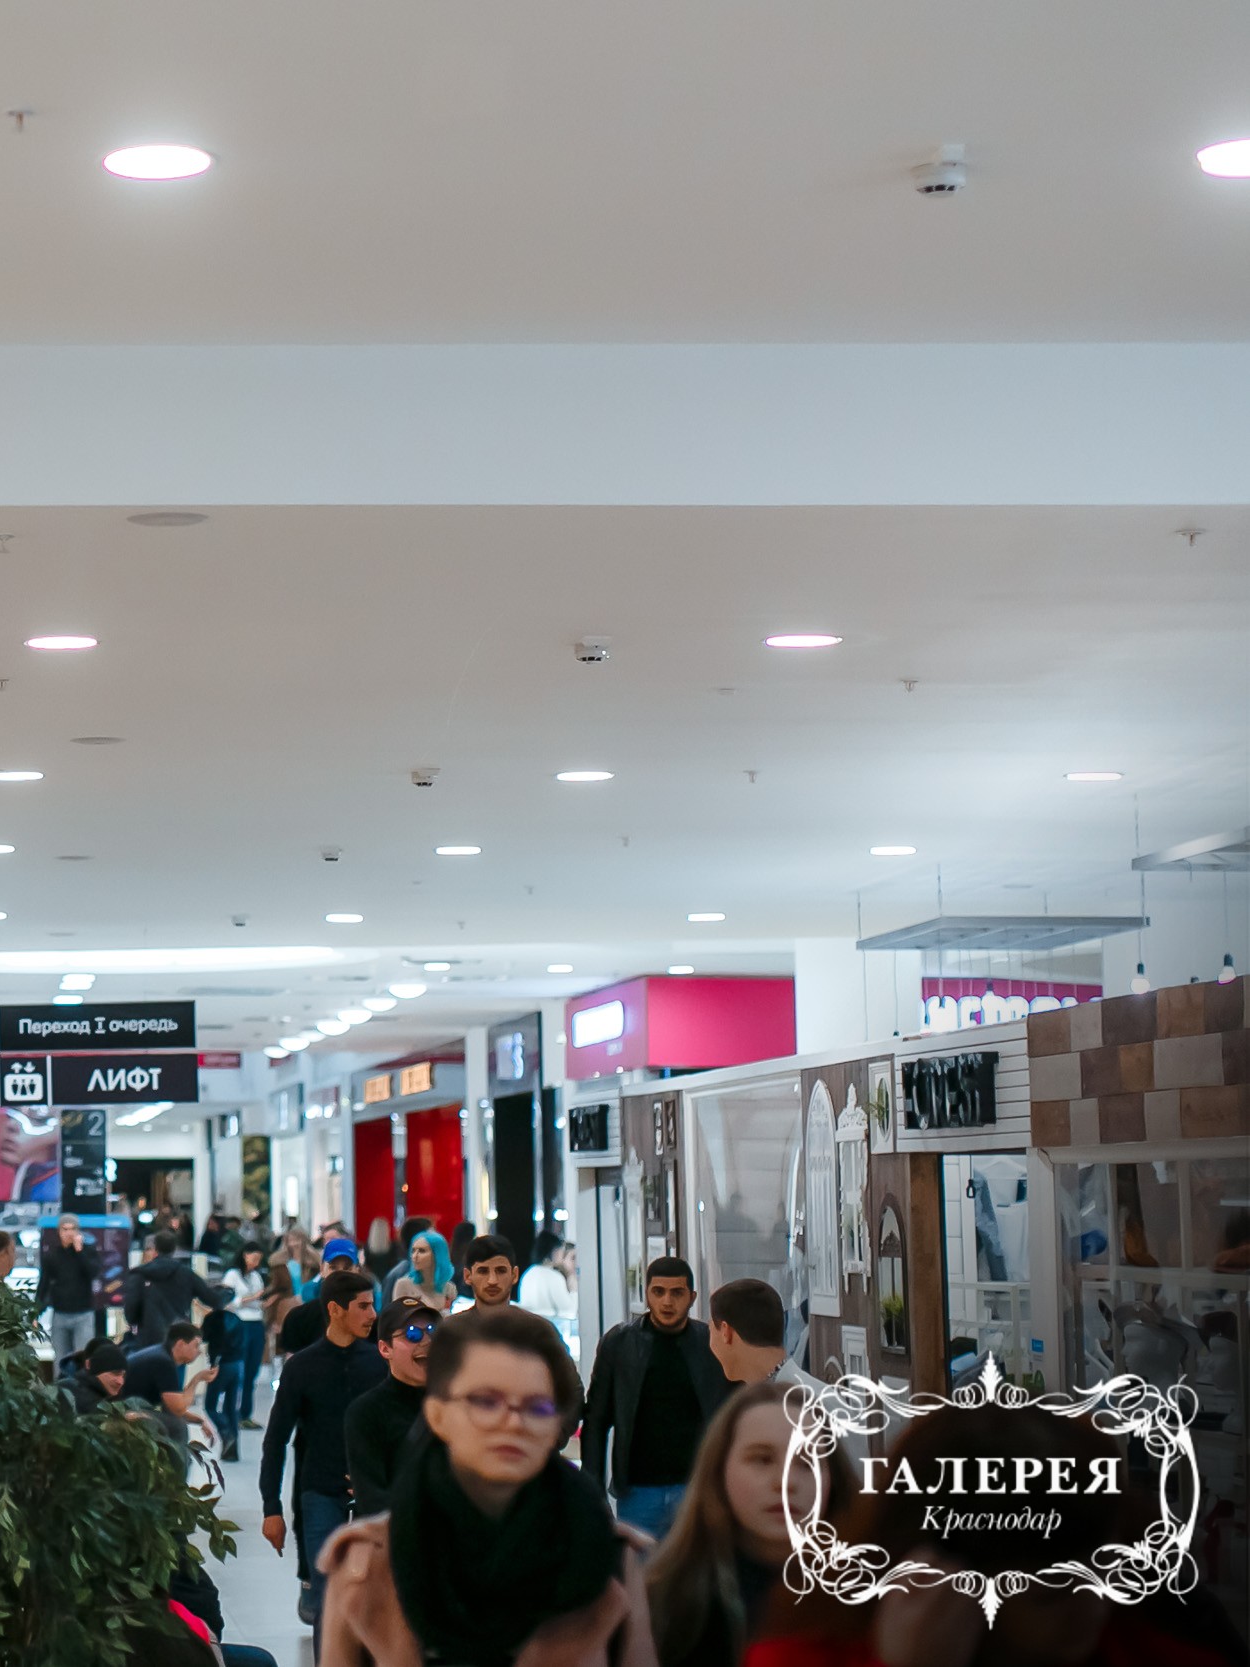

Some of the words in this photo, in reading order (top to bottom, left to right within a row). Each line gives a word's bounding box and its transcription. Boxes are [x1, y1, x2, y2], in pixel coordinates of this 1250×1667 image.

[18, 1018, 91, 1037] Переход
[109, 1018, 179, 1034] очередь
[87, 1066, 162, 1092] ЛИФТ
[87, 1111, 103, 1136] 2
